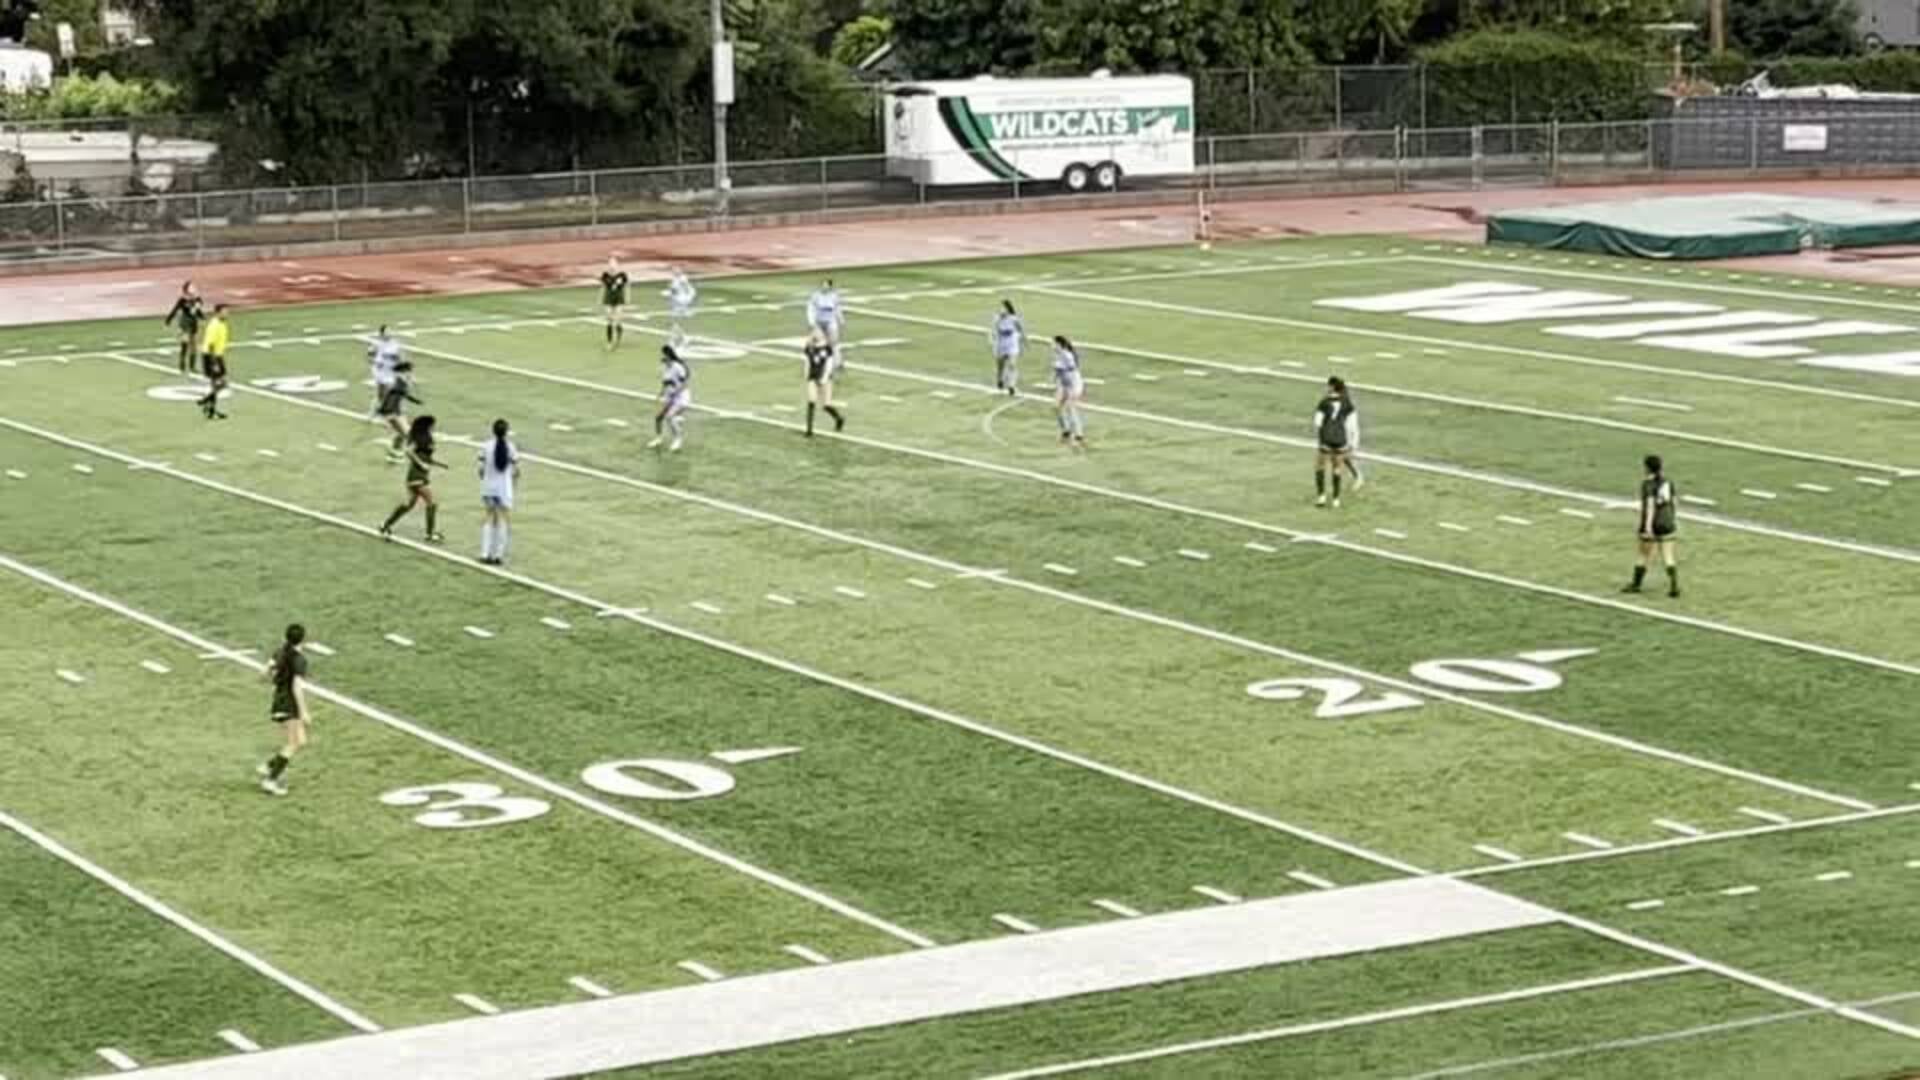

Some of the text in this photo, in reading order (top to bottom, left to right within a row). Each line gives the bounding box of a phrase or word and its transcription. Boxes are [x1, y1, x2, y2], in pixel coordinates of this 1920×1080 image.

[989, 110, 1129, 137] WILDCATS
[1246, 658, 1562, 718] 20
[378, 758, 737, 828] 30
